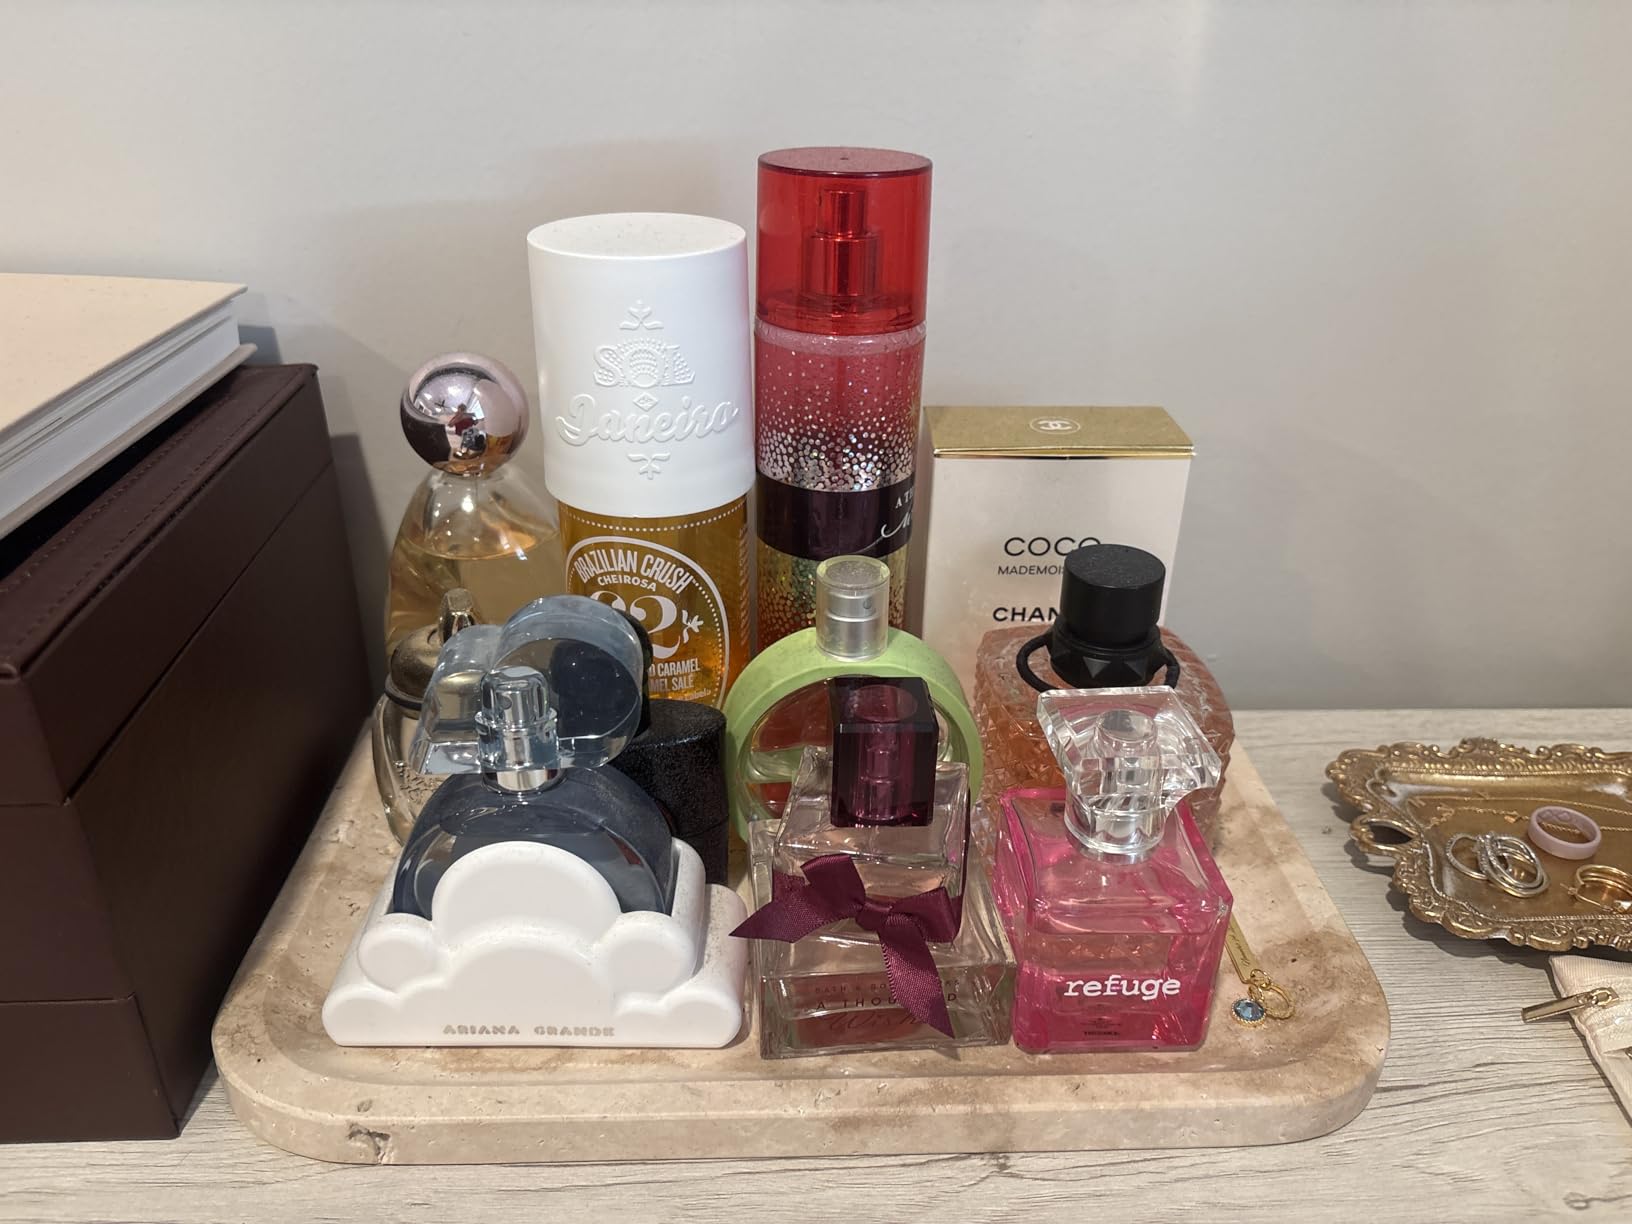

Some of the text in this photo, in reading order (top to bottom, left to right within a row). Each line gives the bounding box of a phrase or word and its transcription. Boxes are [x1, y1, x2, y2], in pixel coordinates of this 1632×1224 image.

[555, 393, 739, 446] Janeiro
[574, 549, 693, 594] BRAZILIAN CRUSH
[597, 574, 657, 592] CHEIROSA
[657, 658, 701, 677] CARAMEL
[648, 676, 670, 693] MEL
[815, 983, 846, 994] BATH
[870, 982, 887, 992] BO
[1063, 974, 1181, 1000] refuge
[816, 992, 957, 1011] A THOUD
[442, 1024, 616, 1038] ARIANA GRANDE
